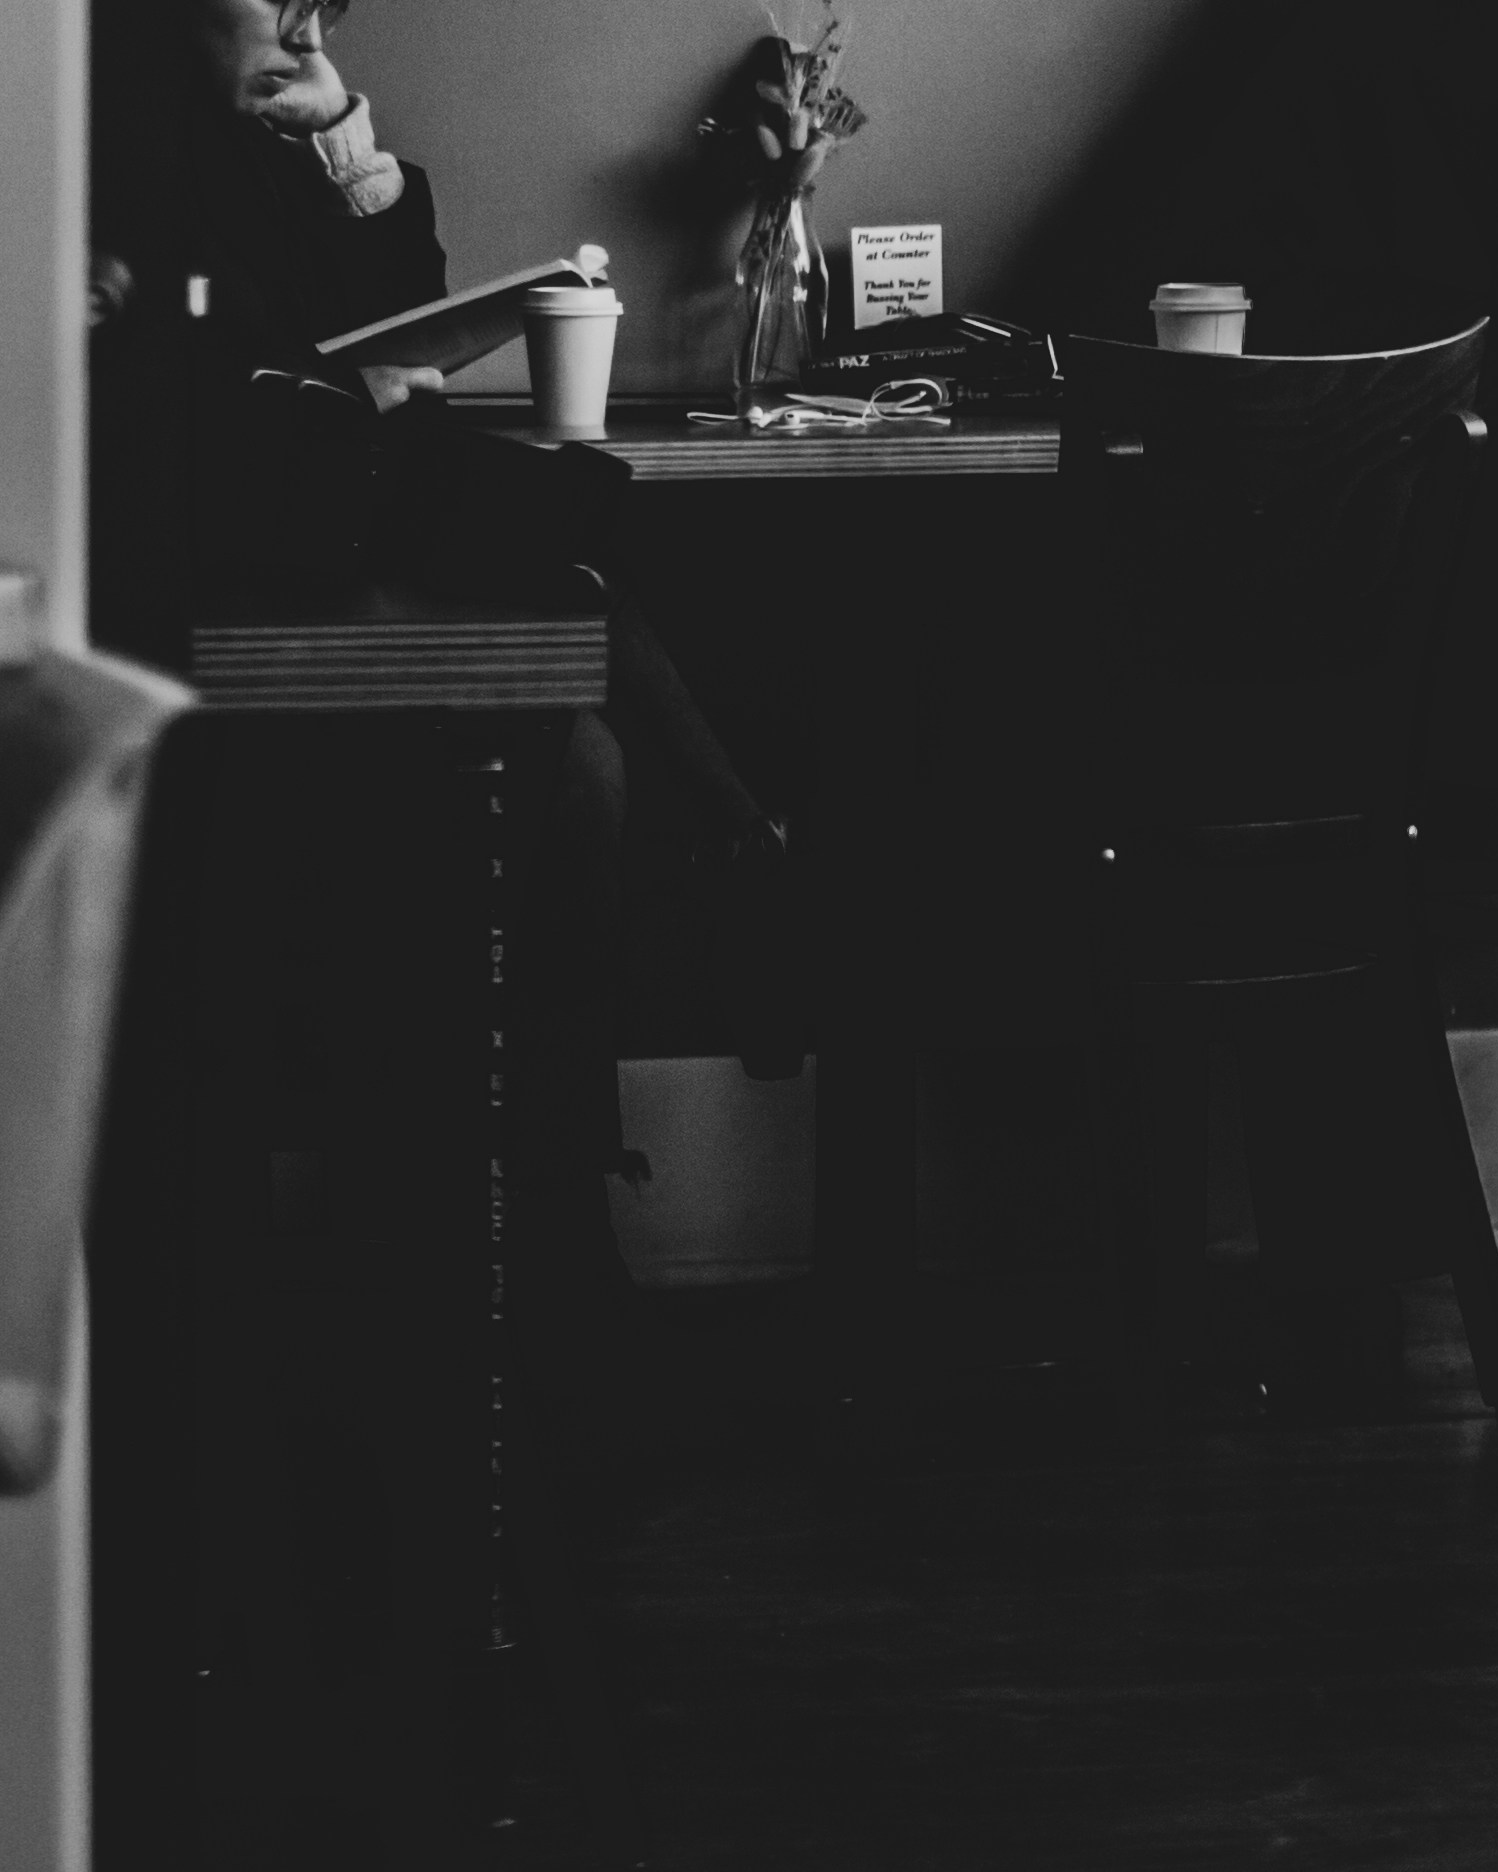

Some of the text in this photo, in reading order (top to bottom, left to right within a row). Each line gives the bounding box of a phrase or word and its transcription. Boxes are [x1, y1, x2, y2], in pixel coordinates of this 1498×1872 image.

[858, 231, 934, 244] Please Order
[866, 249, 930, 260] at Counter
[865, 278, 931, 290] Thank You for
[908, 292, 929, 301] Your
[839, 354, 870, 369] PAZ
